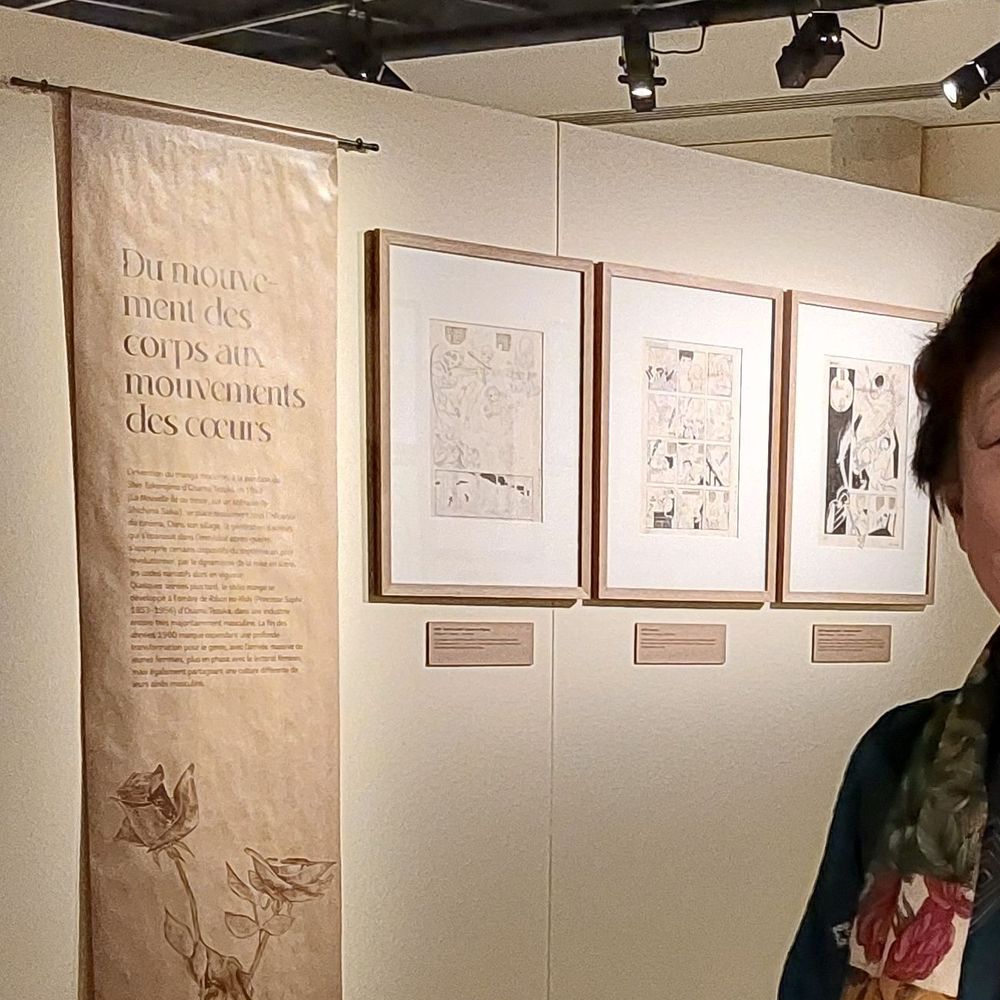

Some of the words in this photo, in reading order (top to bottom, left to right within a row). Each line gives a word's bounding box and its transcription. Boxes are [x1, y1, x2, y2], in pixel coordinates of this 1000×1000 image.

[122, 247, 163, 282] Du
[172, 261, 280, 294] mouve-
[123, 294, 195, 324] ment
[204, 297, 252, 330] des
[123, 333, 208, 369] corps
[215, 344, 265, 369] aux
[125, 373, 306, 408] mouvements
[126, 404, 178, 436] des
[185, 414, 272, 442] cœurs
